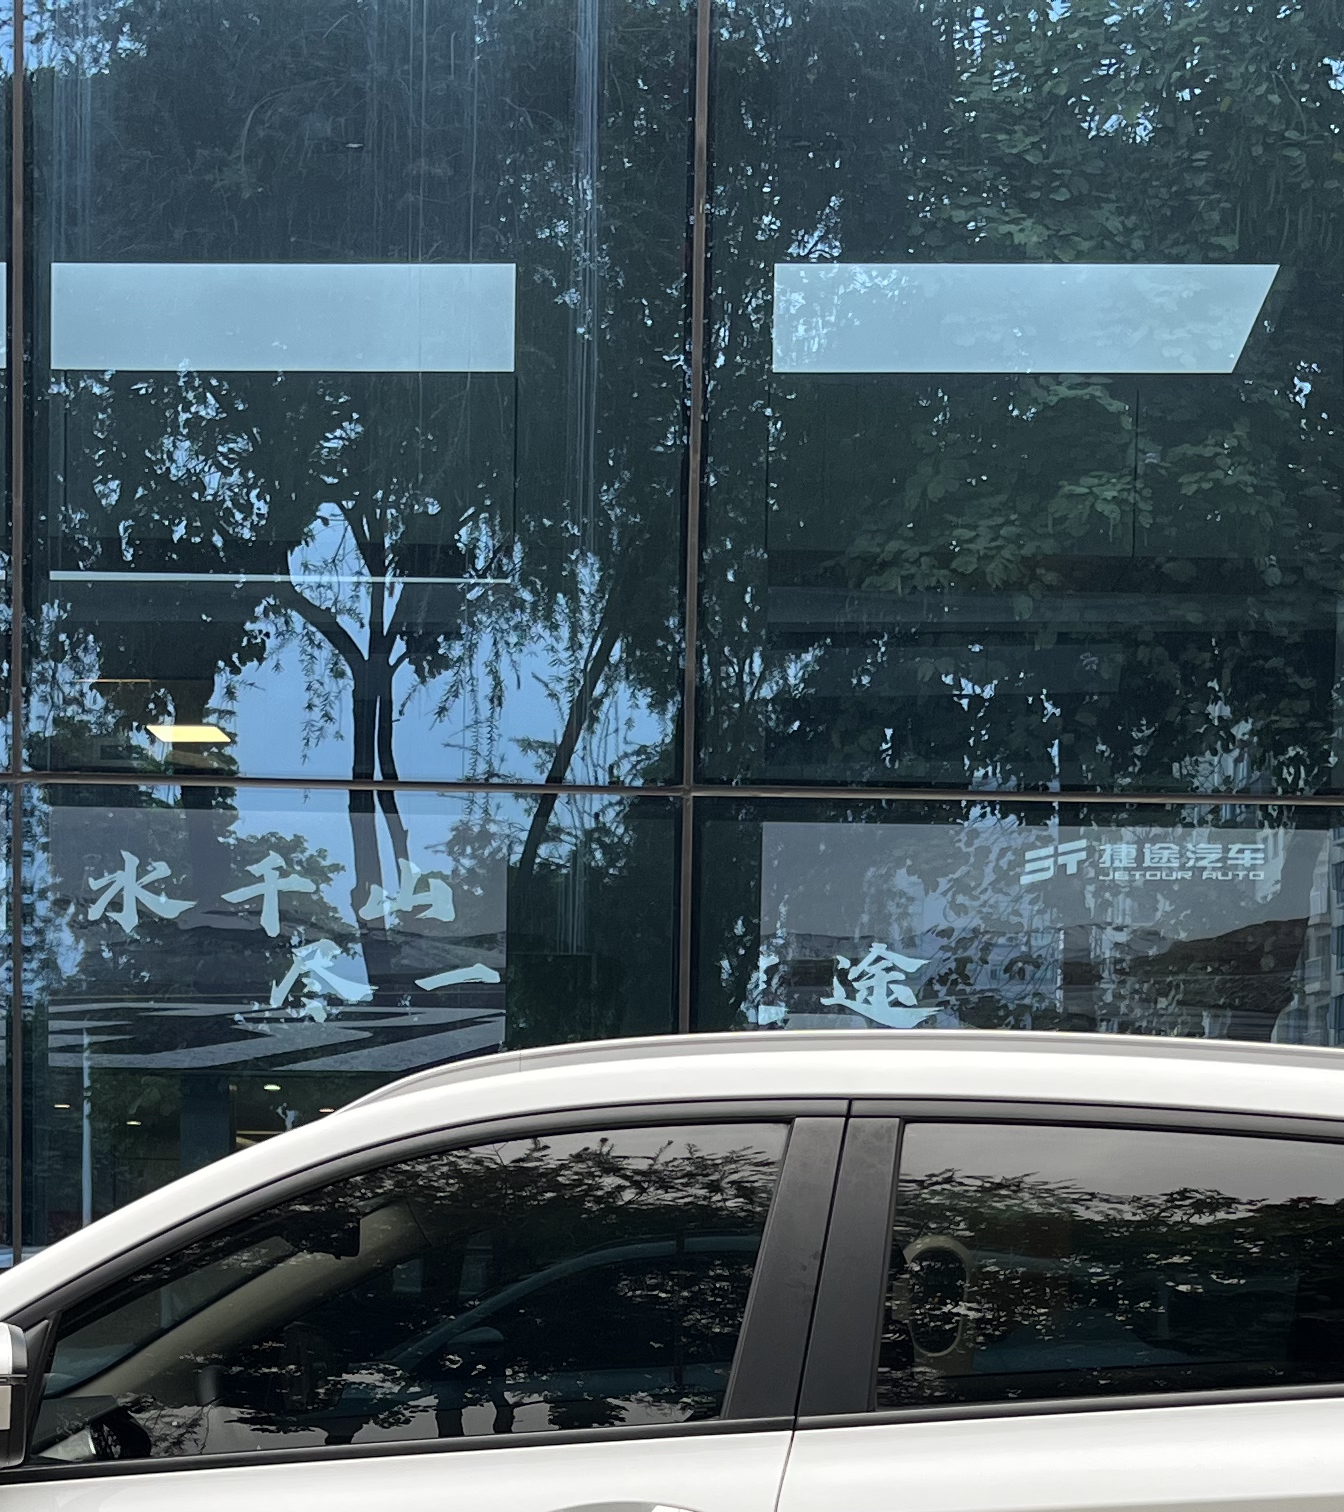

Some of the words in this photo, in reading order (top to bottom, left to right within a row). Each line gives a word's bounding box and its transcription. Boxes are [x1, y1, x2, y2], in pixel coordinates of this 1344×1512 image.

[1099, 843, 1265, 868] 捷途汽车
[1099, 871, 1193, 880] JETOUR
[1201, 871, 1265, 880] AUTO
